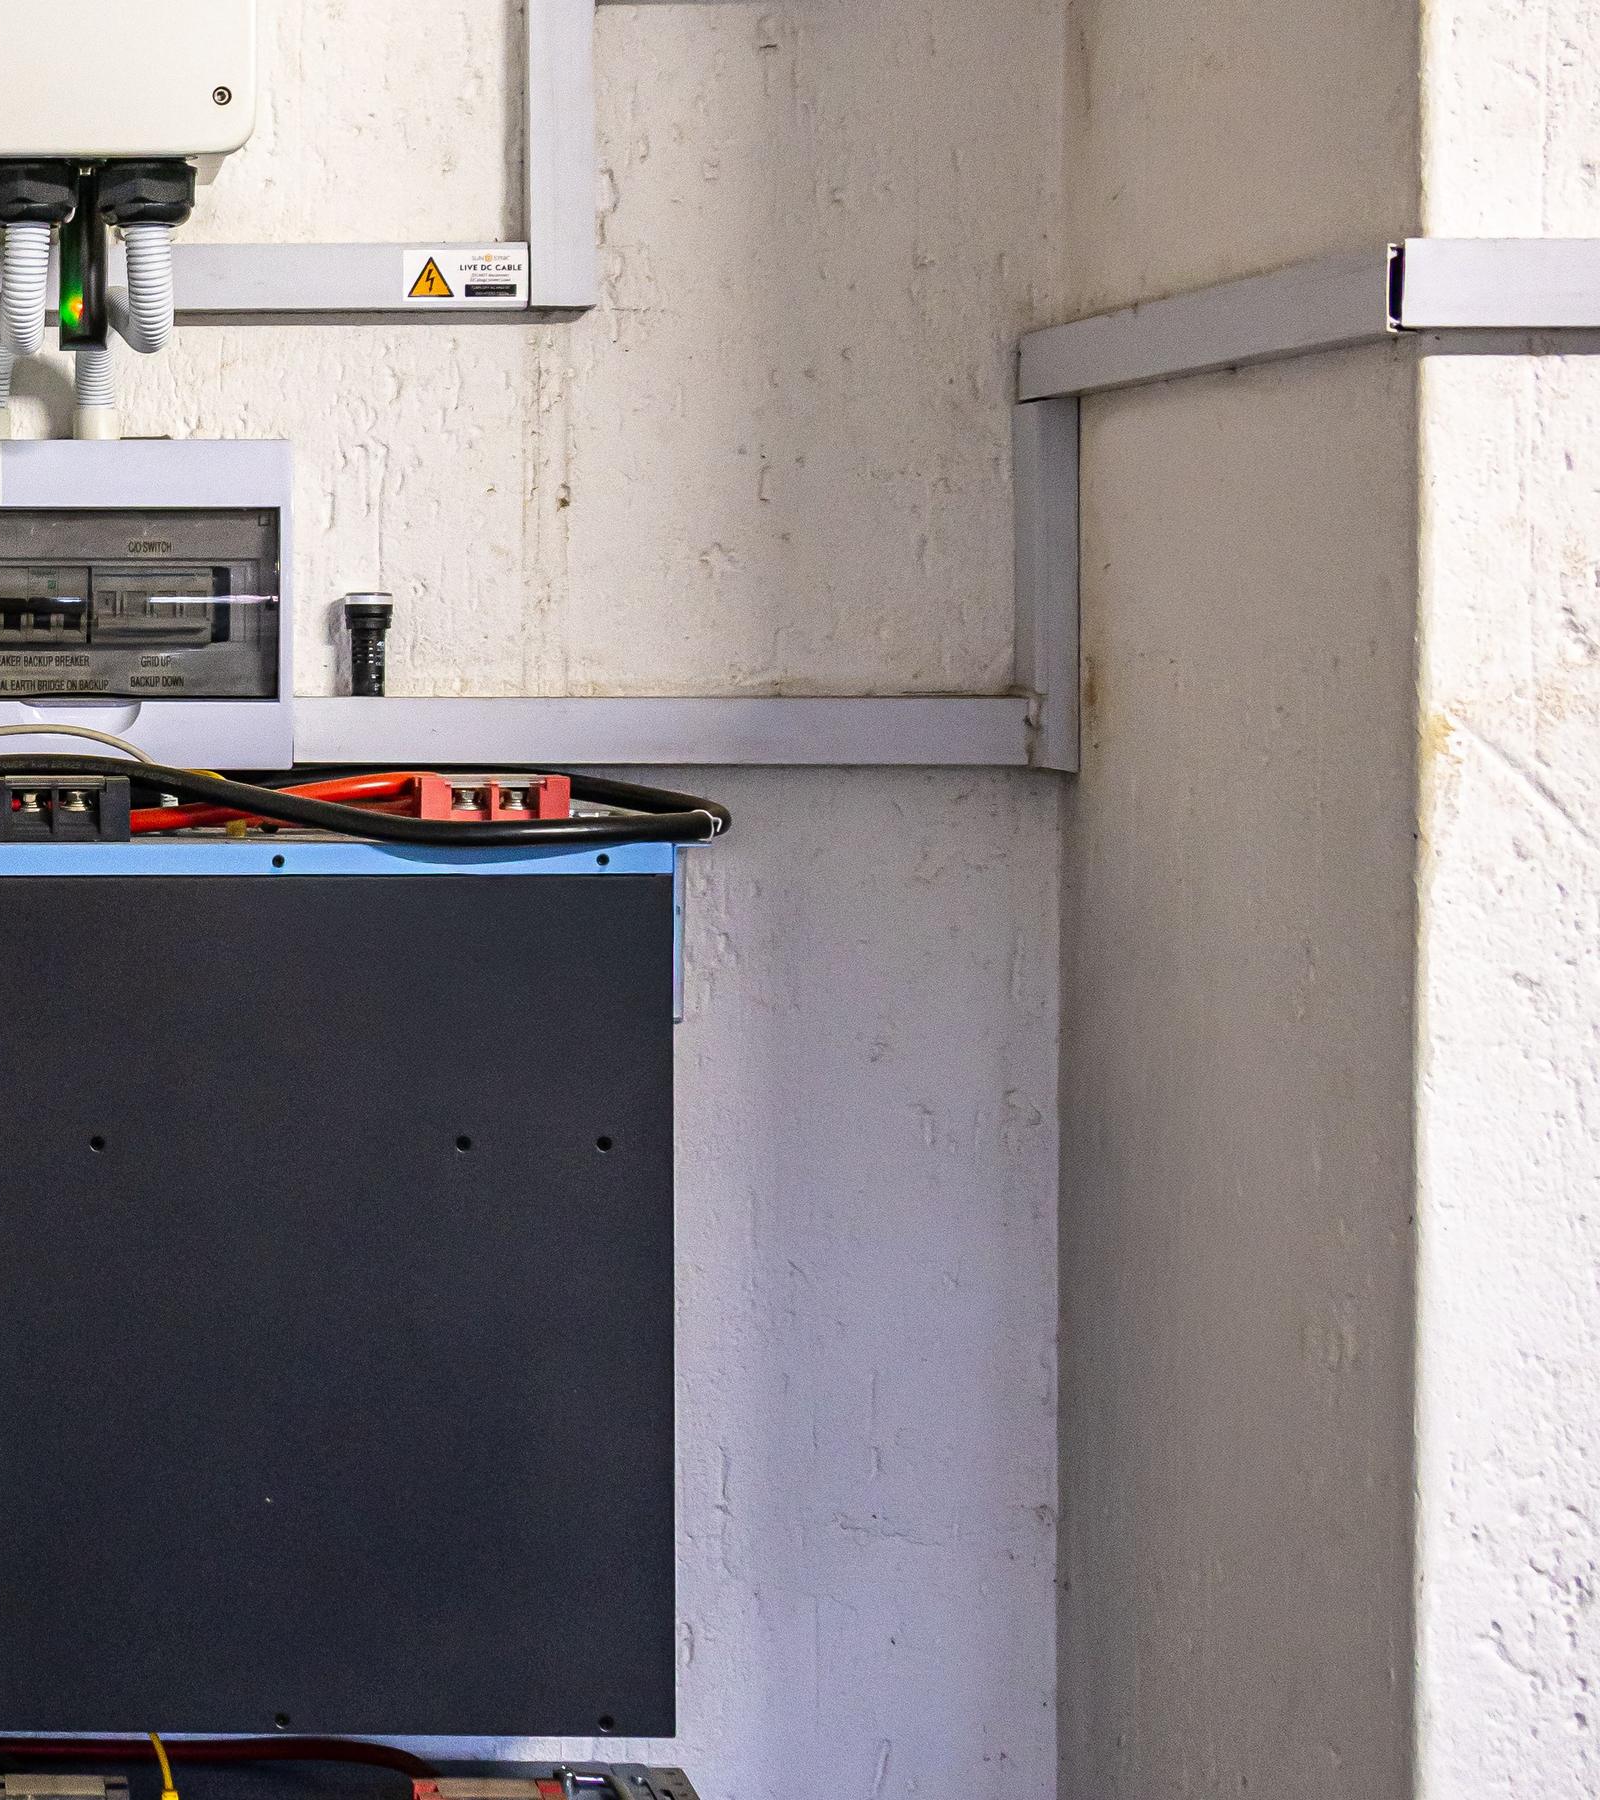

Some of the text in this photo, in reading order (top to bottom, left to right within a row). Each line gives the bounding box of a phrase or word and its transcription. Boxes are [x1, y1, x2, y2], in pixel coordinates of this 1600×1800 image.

[142, 541, 172, 552] SWITCH
[23, 655, 54, 667] BACKUP
[55, 655, 90, 667] BREAKER
[140, 655, 172, 667] GRID UP
[10, 680, 36, 692] EARTH
[37, 679, 65, 691] BRIDGE
[66, 679, 78, 691] ON
[79, 679, 109, 691] BACKUP
[130, 675, 185, 687] BACKUP DOWN
